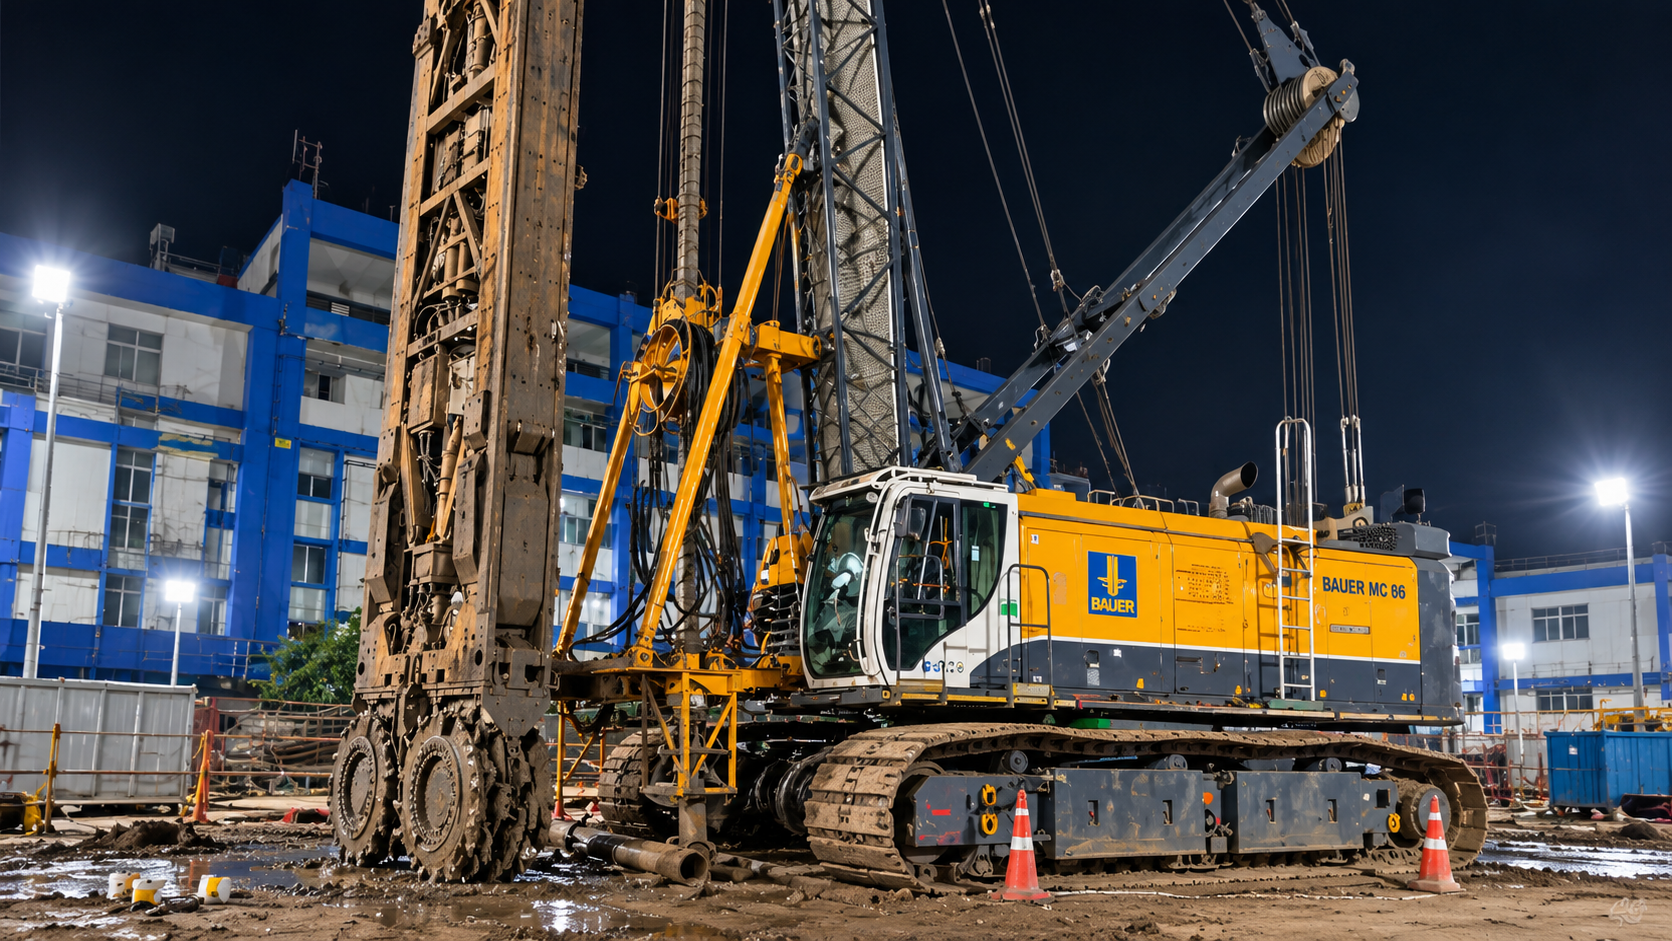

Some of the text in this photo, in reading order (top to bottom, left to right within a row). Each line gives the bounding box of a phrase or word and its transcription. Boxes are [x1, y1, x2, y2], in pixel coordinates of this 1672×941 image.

[1322, 576, 1365, 595] BAUER
[1368, 581, 1388, 597] MC
[1091, 596, 1135, 614] BAUER
